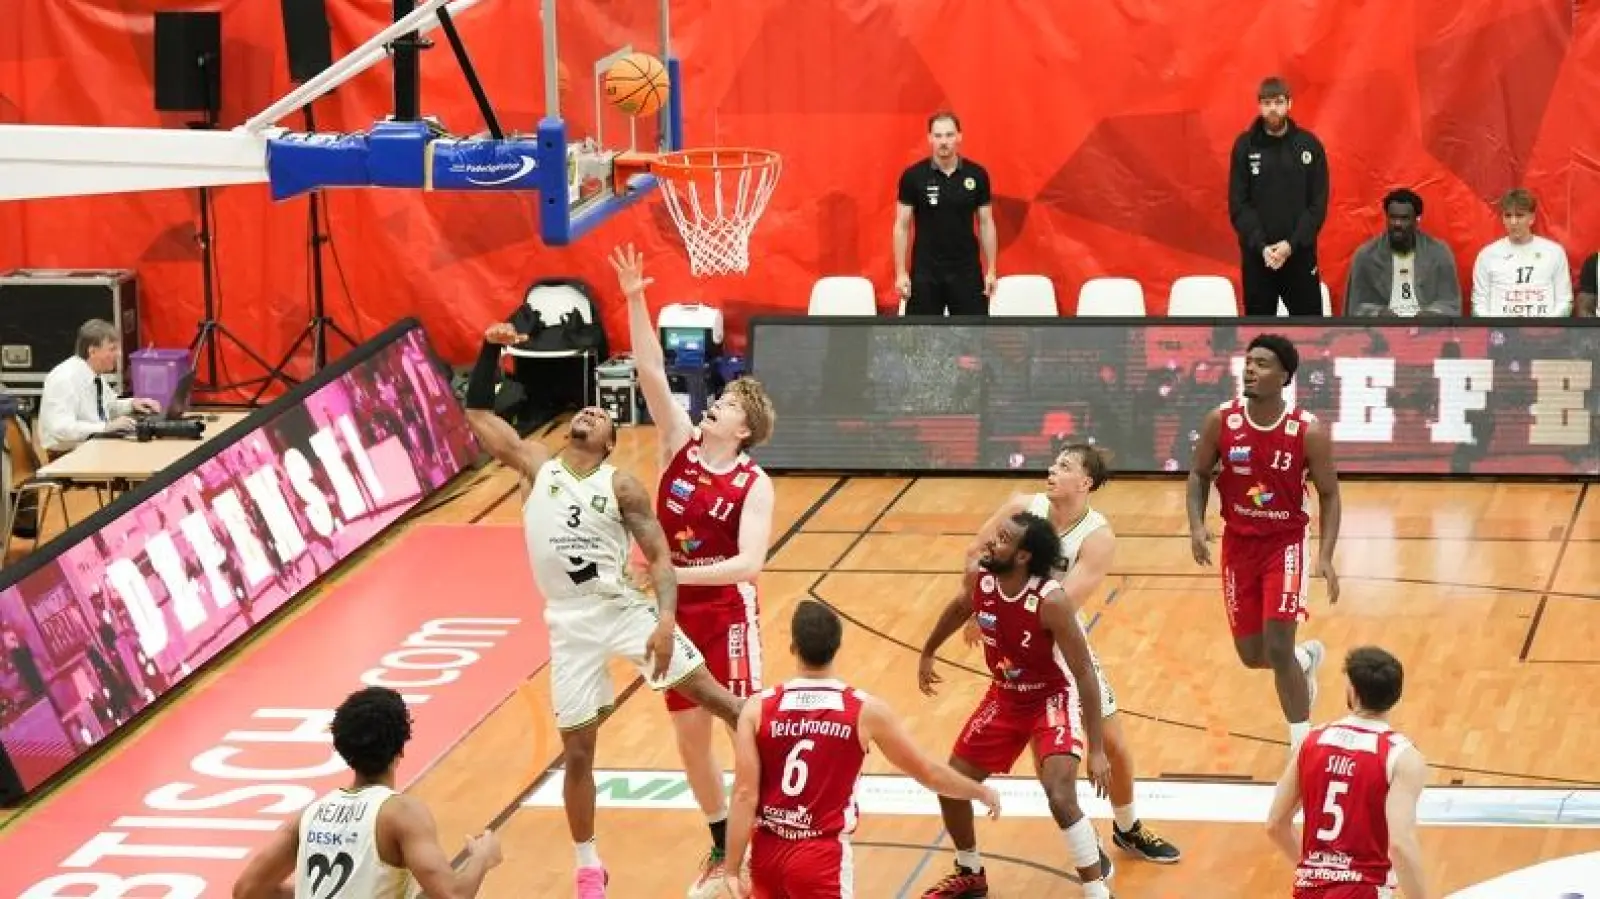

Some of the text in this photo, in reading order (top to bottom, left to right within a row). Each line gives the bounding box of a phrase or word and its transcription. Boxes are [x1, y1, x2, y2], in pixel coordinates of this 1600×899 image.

[1514, 266, 1534, 284] 17
[1402, 282, 1411, 299] 8
[1270, 450, 1293, 471] 13
[567, 505, 581, 528] 3
[709, 497, 734, 521] 11
[1278, 593, 1298, 613] 13
[1021, 631, 1032, 648] 2
[770, 717, 852, 739] Teichmann
[1054, 726, 1066, 745] 2
[781, 739, 815, 797] 6
[1316, 781, 1349, 841] 5
[306, 831, 343, 845] DESK
